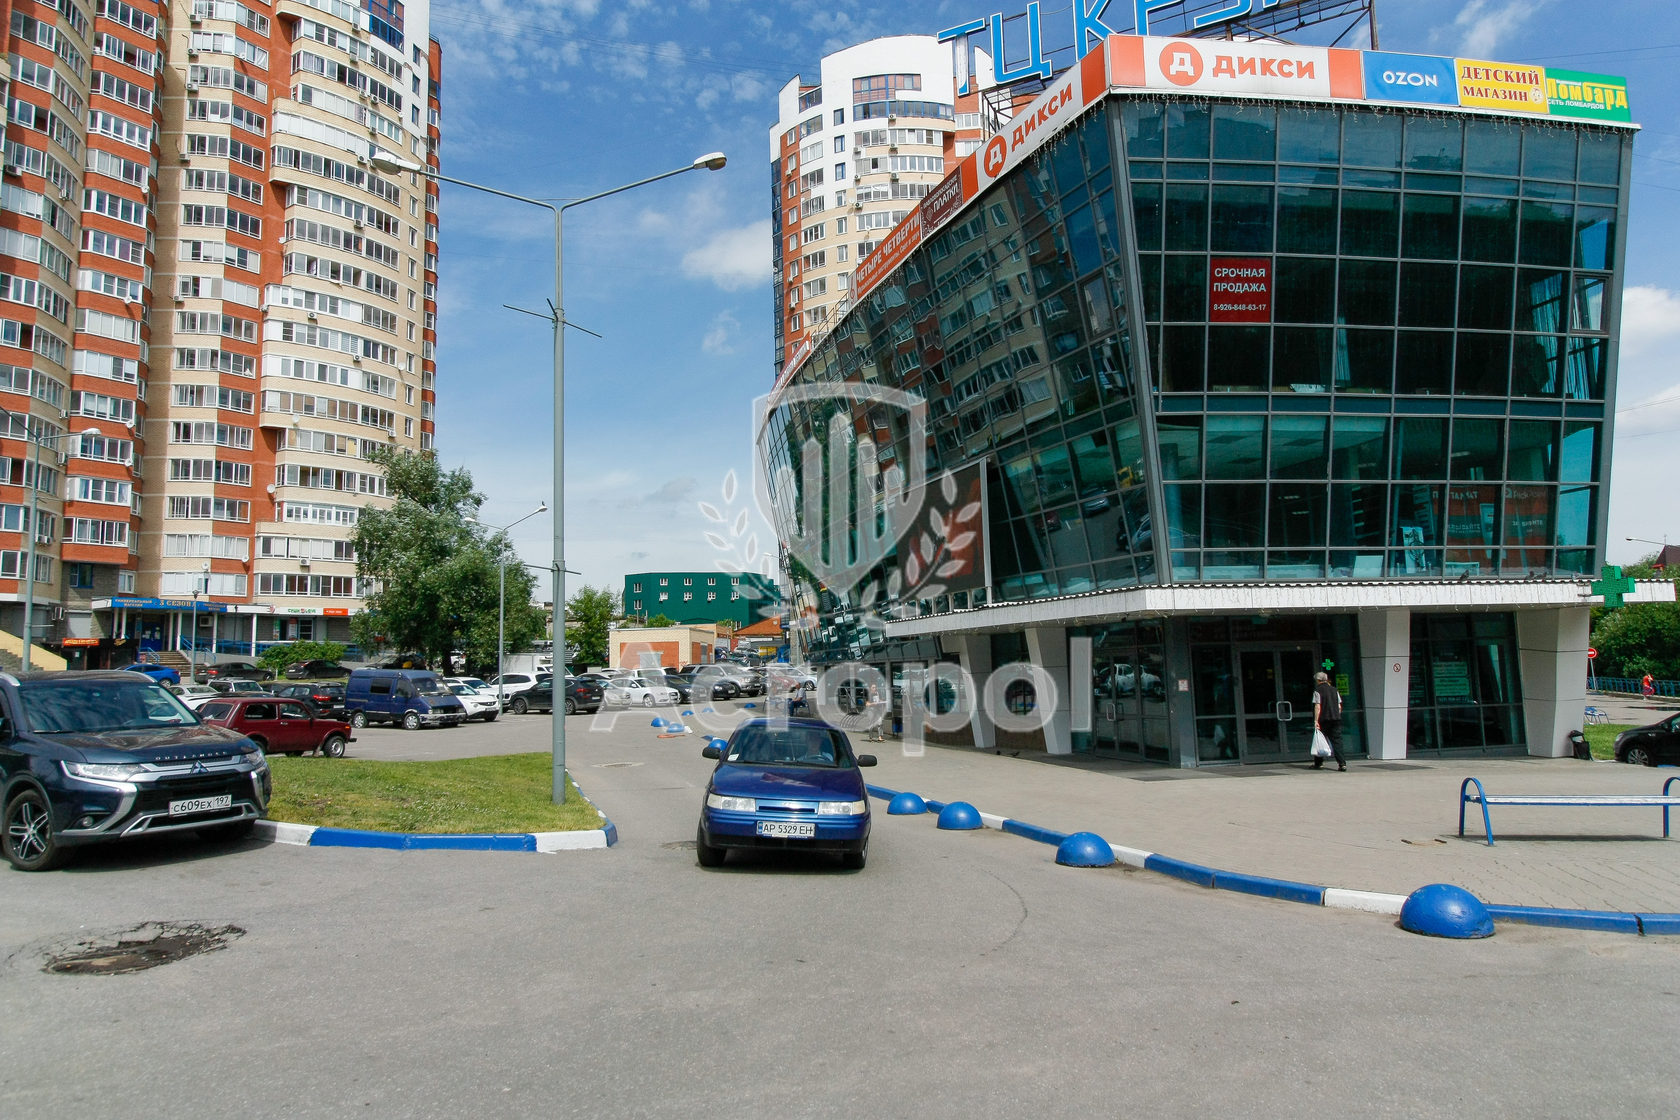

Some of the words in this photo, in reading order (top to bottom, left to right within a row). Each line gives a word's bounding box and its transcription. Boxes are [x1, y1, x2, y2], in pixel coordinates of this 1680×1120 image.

[937, 1, 1053, 97] ТЦ
[1212, 54, 1316, 80] ДИКСИ
[1461, 66, 1540, 86] ДЕТСКИЙ
[1382, 70, 1438, 87] OZON
[1462, 85, 1529, 102] МАГАЗИН
[1011, 82, 1072, 152] ДИКСИ
[933, 182, 959, 213] ПЛАТКИ
[857, 250, 882, 282] ЧЕТЫРЕ
[1214, 267, 1266, 277] СРОЧНАЯ
[1213, 282, 1267, 294] ПРОДАЖА
[215, 796, 229, 806] 197
[778, 825, 797, 834] 5329
